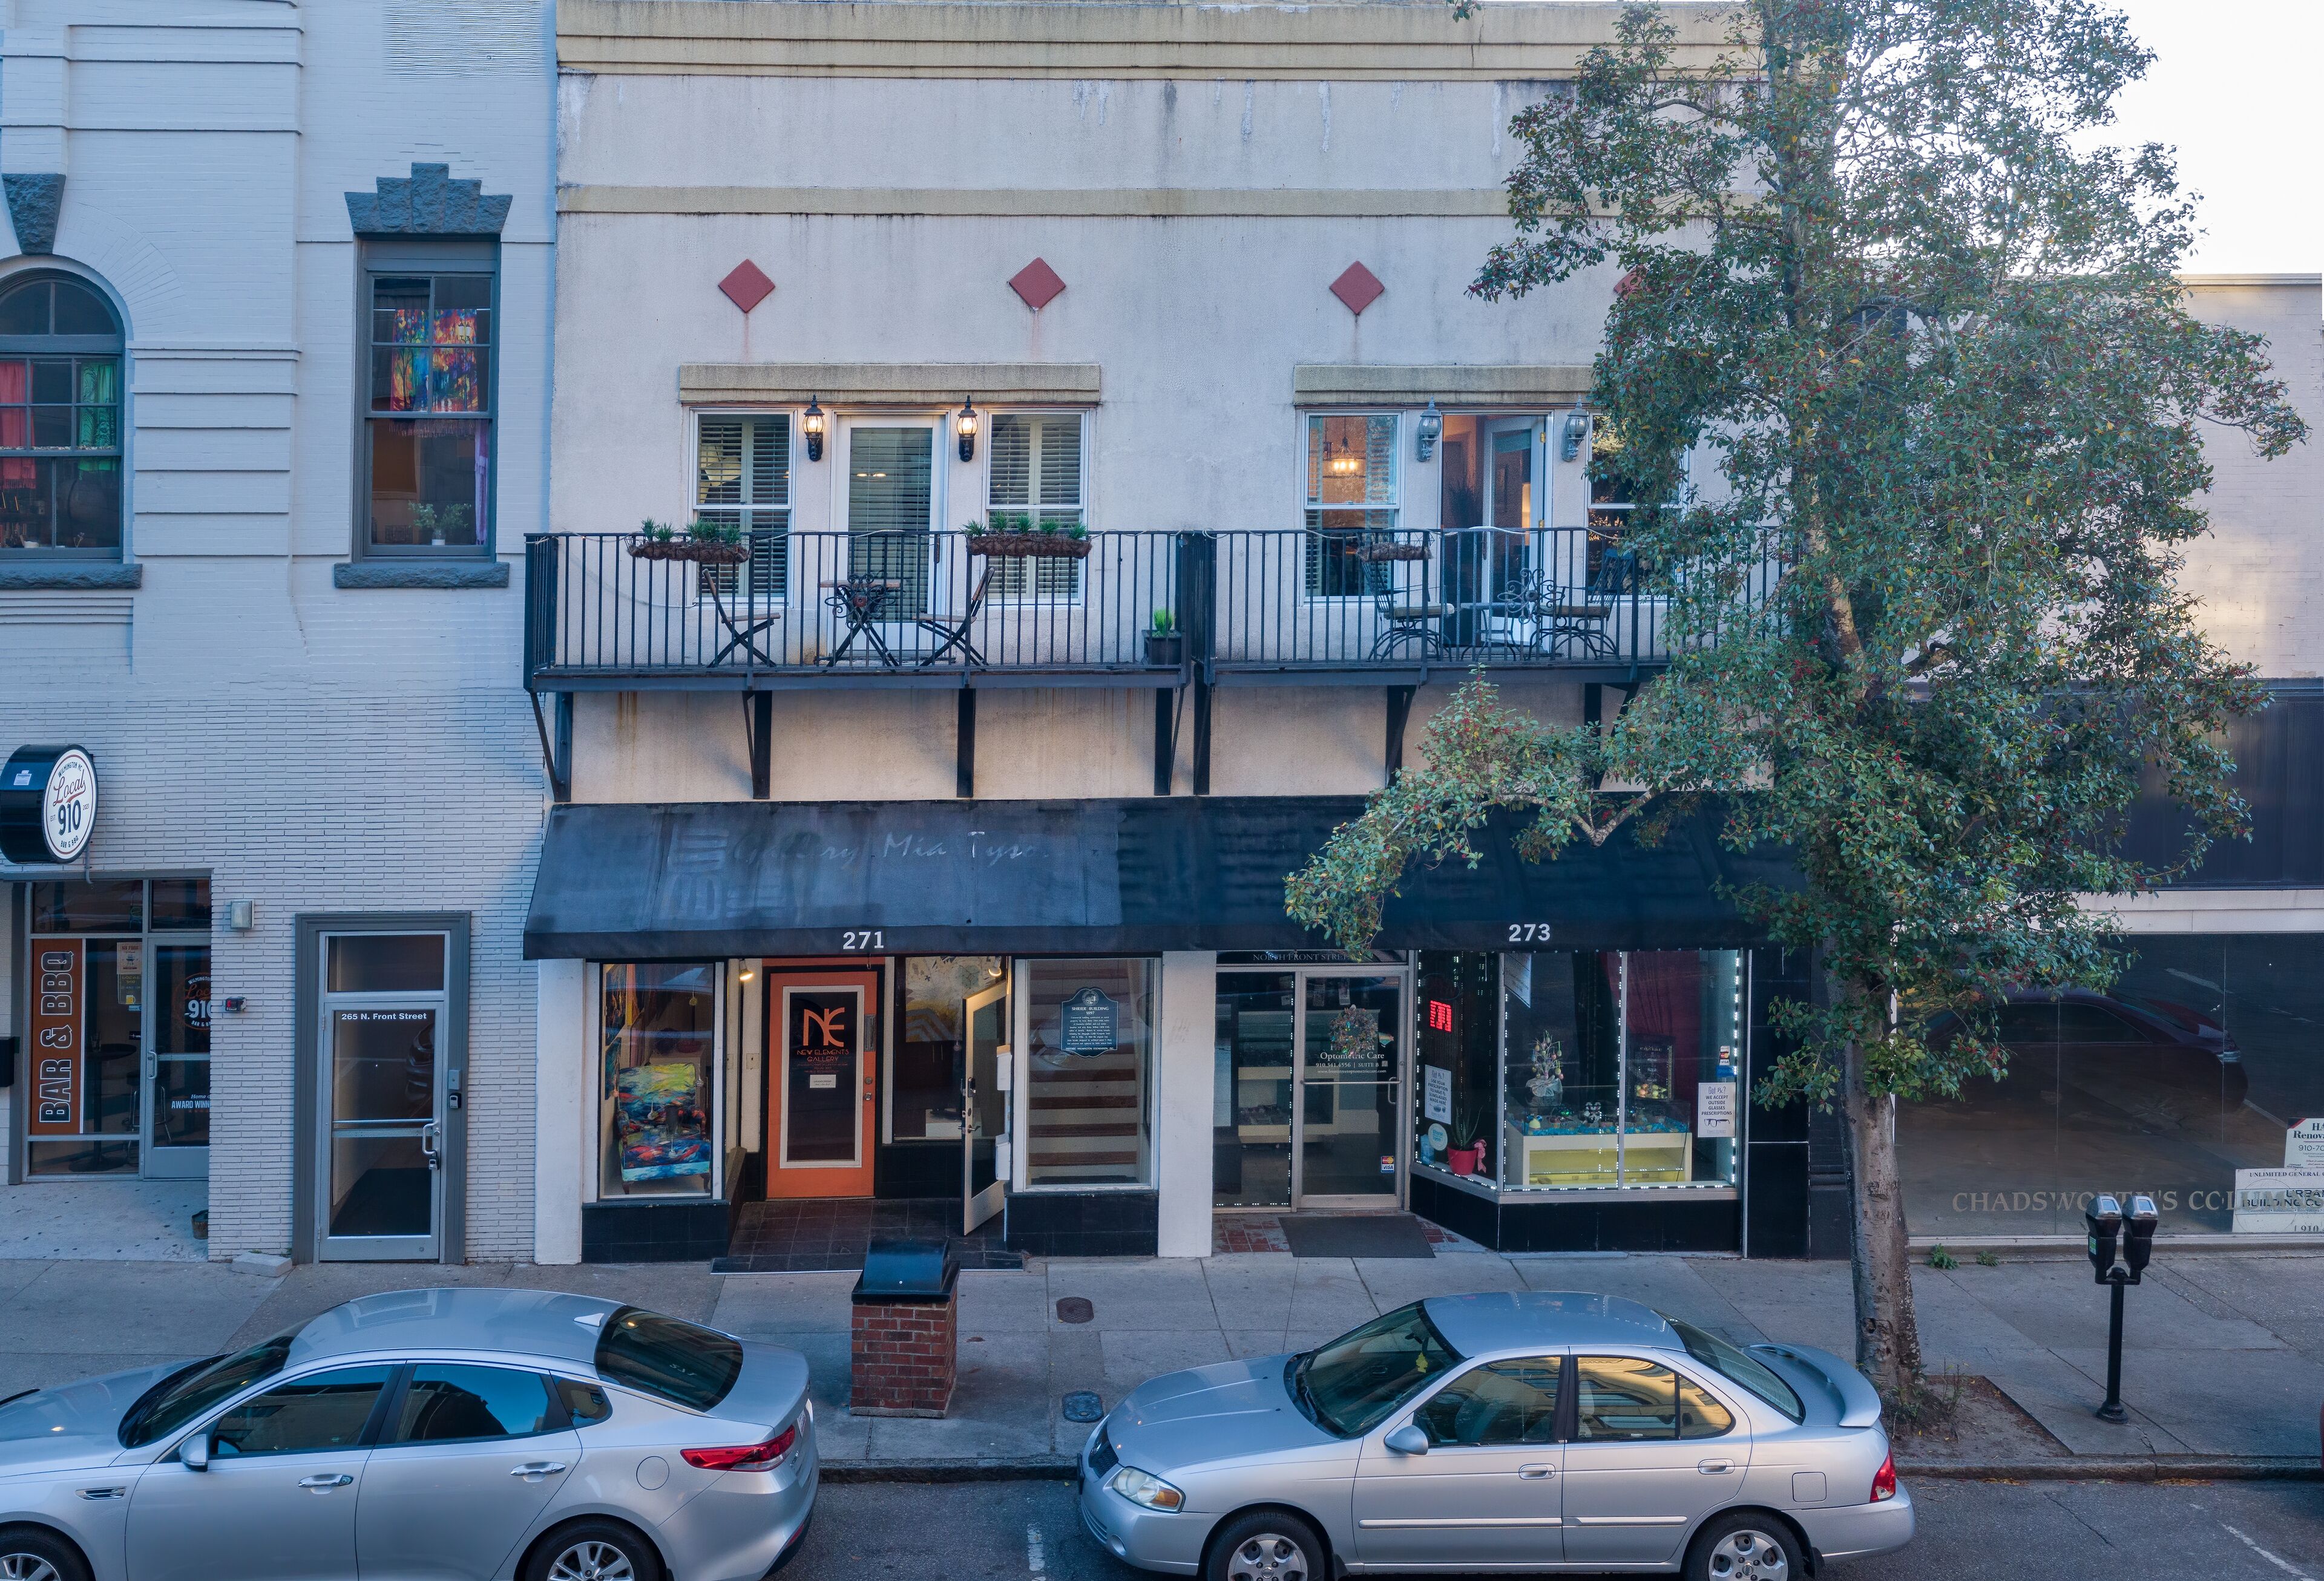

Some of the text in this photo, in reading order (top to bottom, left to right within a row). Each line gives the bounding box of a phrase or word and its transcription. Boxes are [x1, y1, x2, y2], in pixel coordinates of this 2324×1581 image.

[57, 761, 77, 777] WILMINGTON
[53, 768, 86, 807] Local
[58, 800, 81, 836] 910
[882, 831, 947, 857] Mia
[968, 831, 1048, 868] Tyso
[843, 931, 884, 949] 271
[1509, 924, 1551, 941] 273
[188, 976, 211, 984] WILMINGTO
[39, 951, 74, 1122] BAR & BBQ
[1320, 1052, 1365, 1061] Optometric
[2293, 1130, 2324, 1139] Renov
[1952, 1190, 2178, 1212] CHADSWOT'S
[2242, 1199, 2300, 1207] BUILDING
